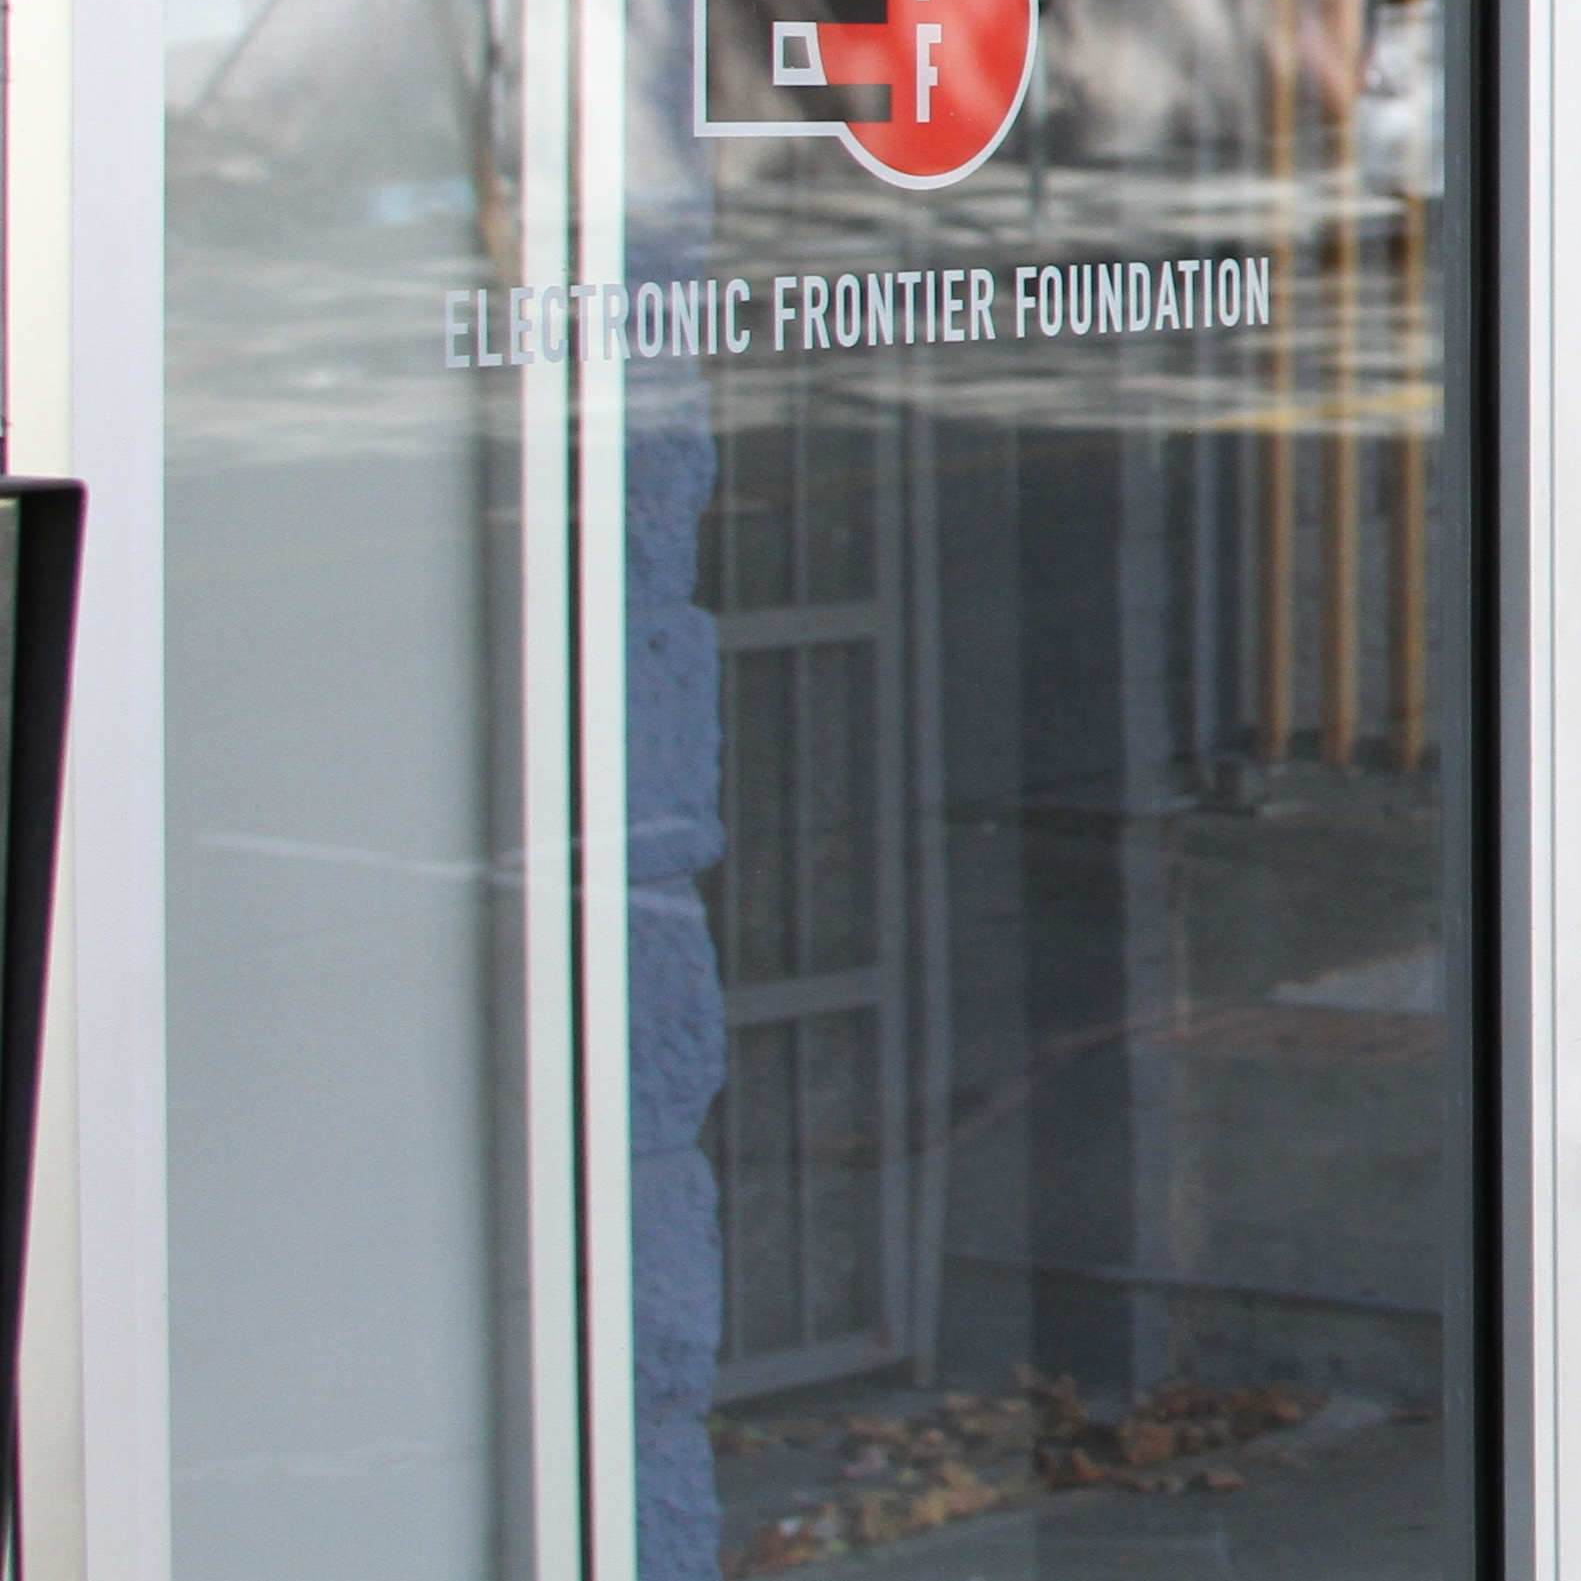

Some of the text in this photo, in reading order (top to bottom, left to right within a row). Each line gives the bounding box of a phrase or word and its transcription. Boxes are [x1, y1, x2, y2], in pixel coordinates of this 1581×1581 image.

[445, 256, 1271, 369] ELECTRONIC FRONTIER FOUNDATION
